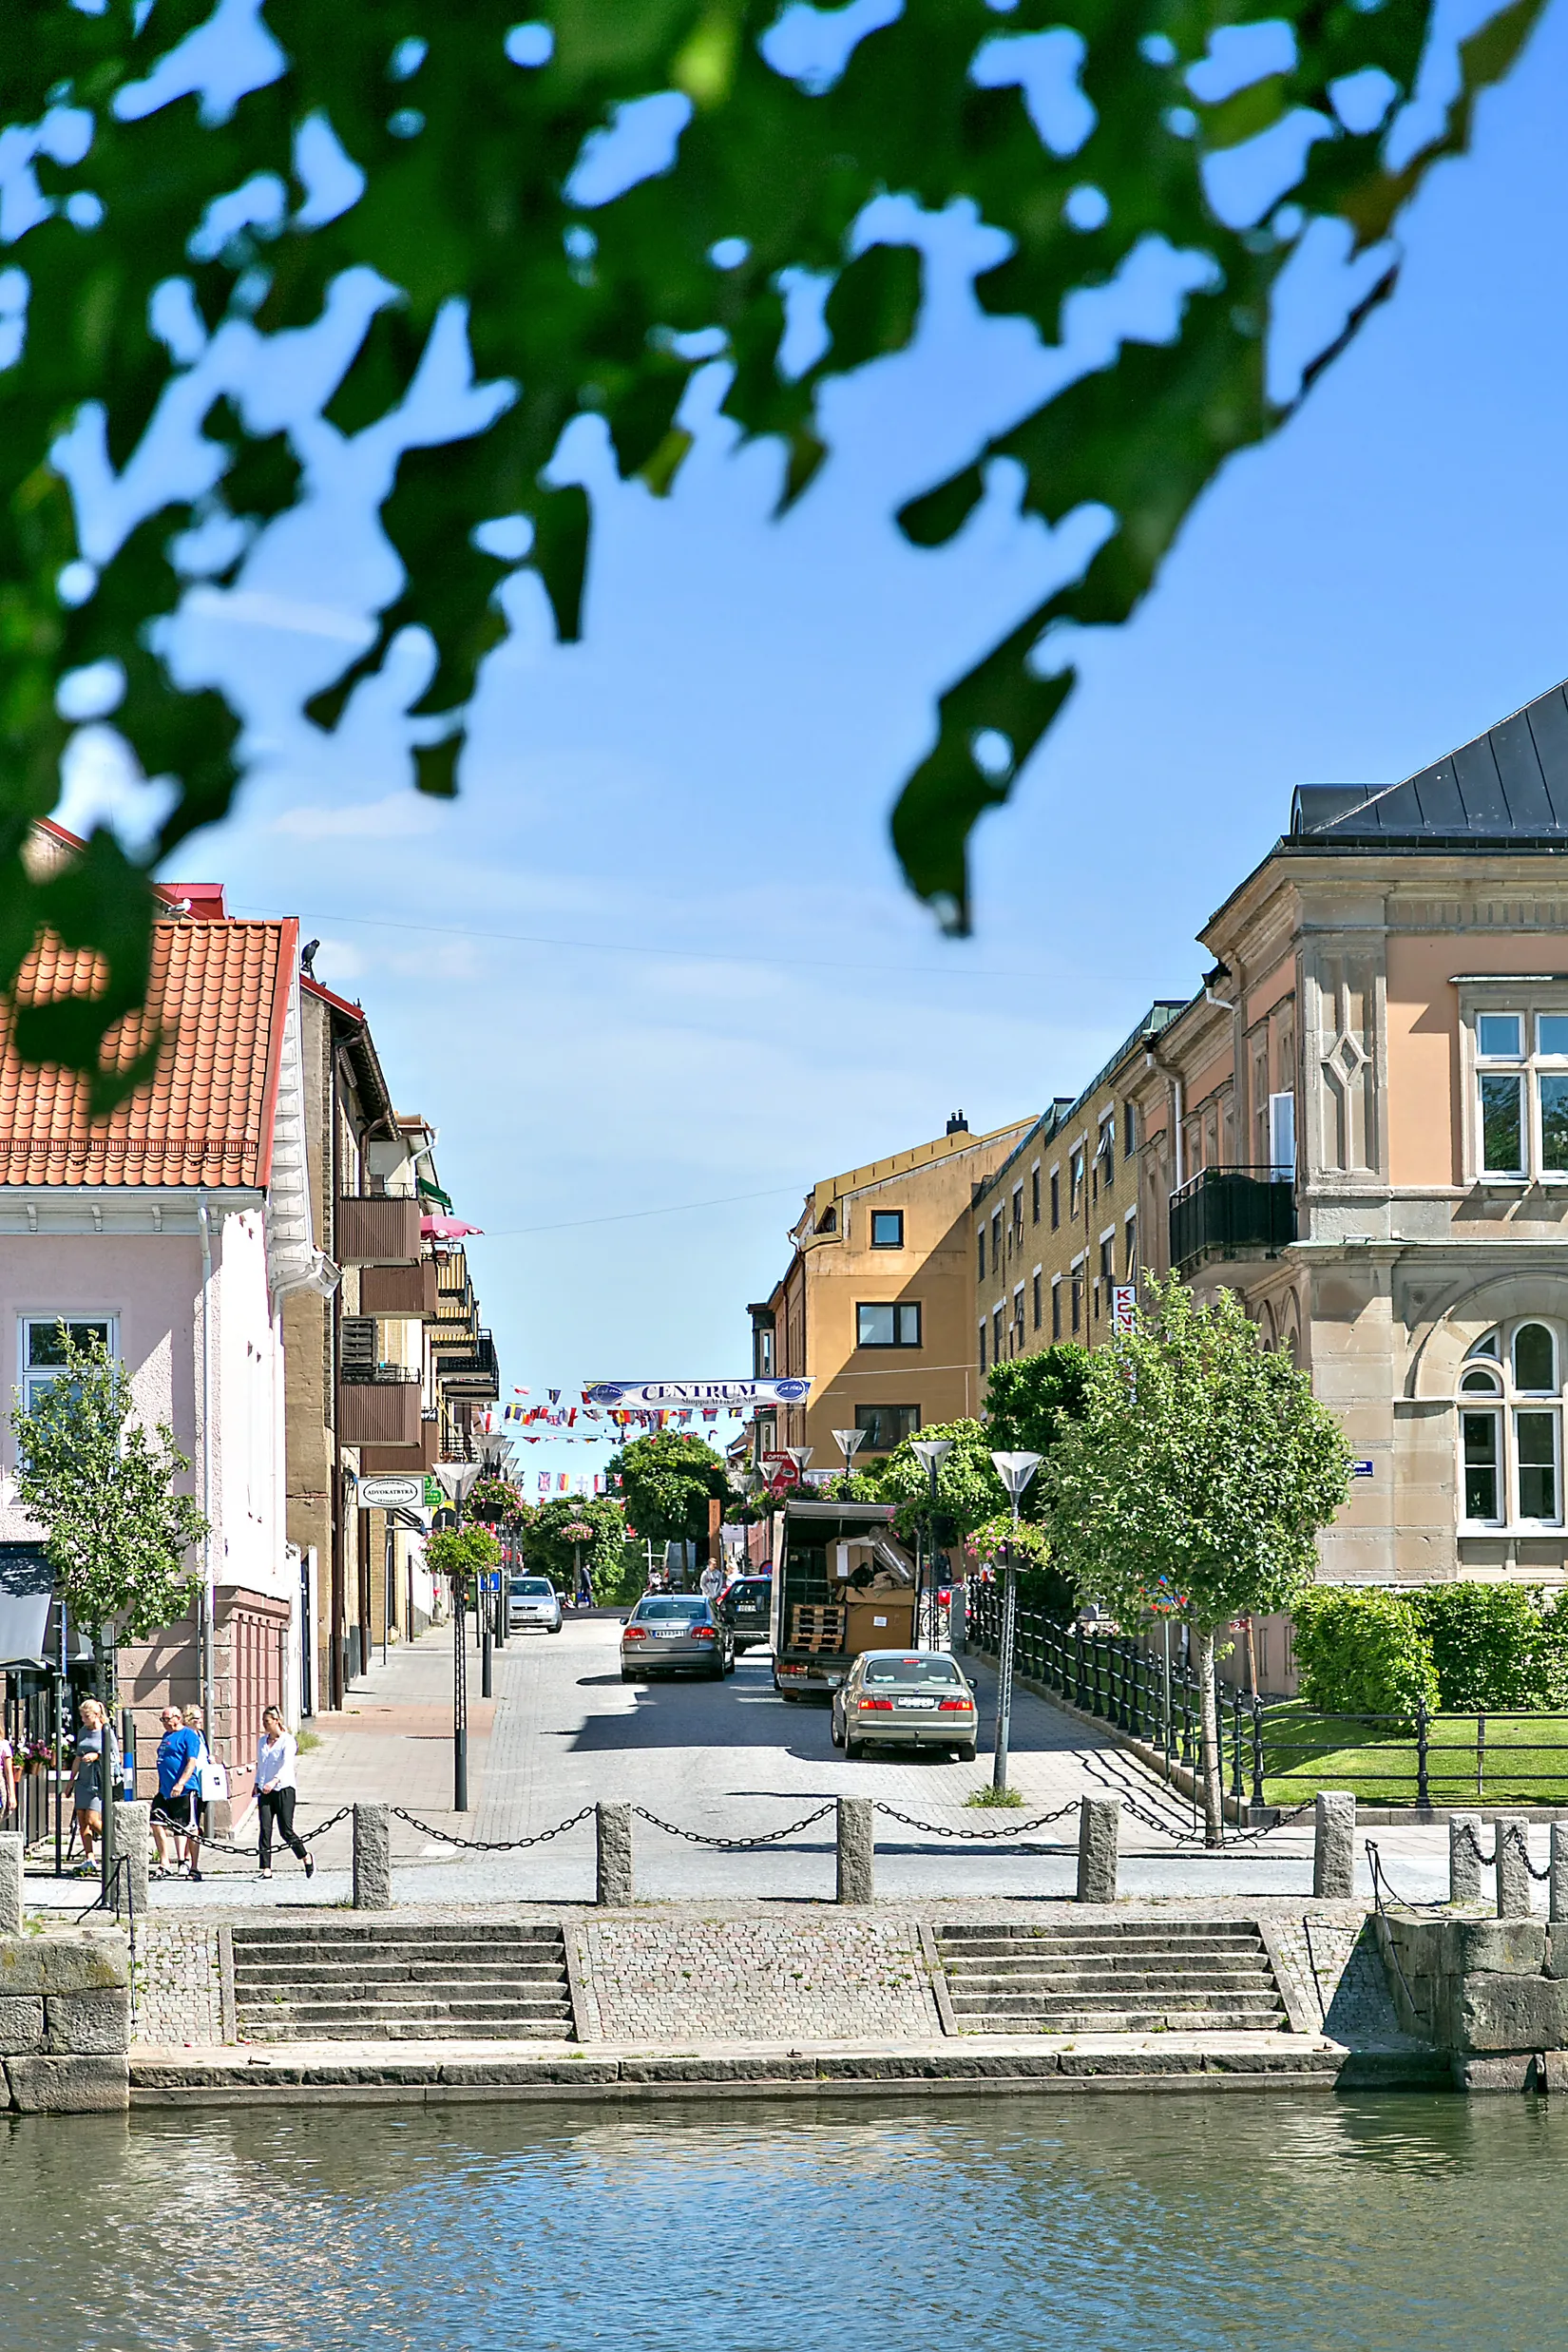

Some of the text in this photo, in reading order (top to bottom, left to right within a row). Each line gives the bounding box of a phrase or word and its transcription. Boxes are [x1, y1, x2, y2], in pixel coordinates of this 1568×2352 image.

[641, 1384, 756, 1402] CENTRUM
[681, 1397, 710, 1406] Shoppa
[1234, 1622, 1241, 1631] 2
